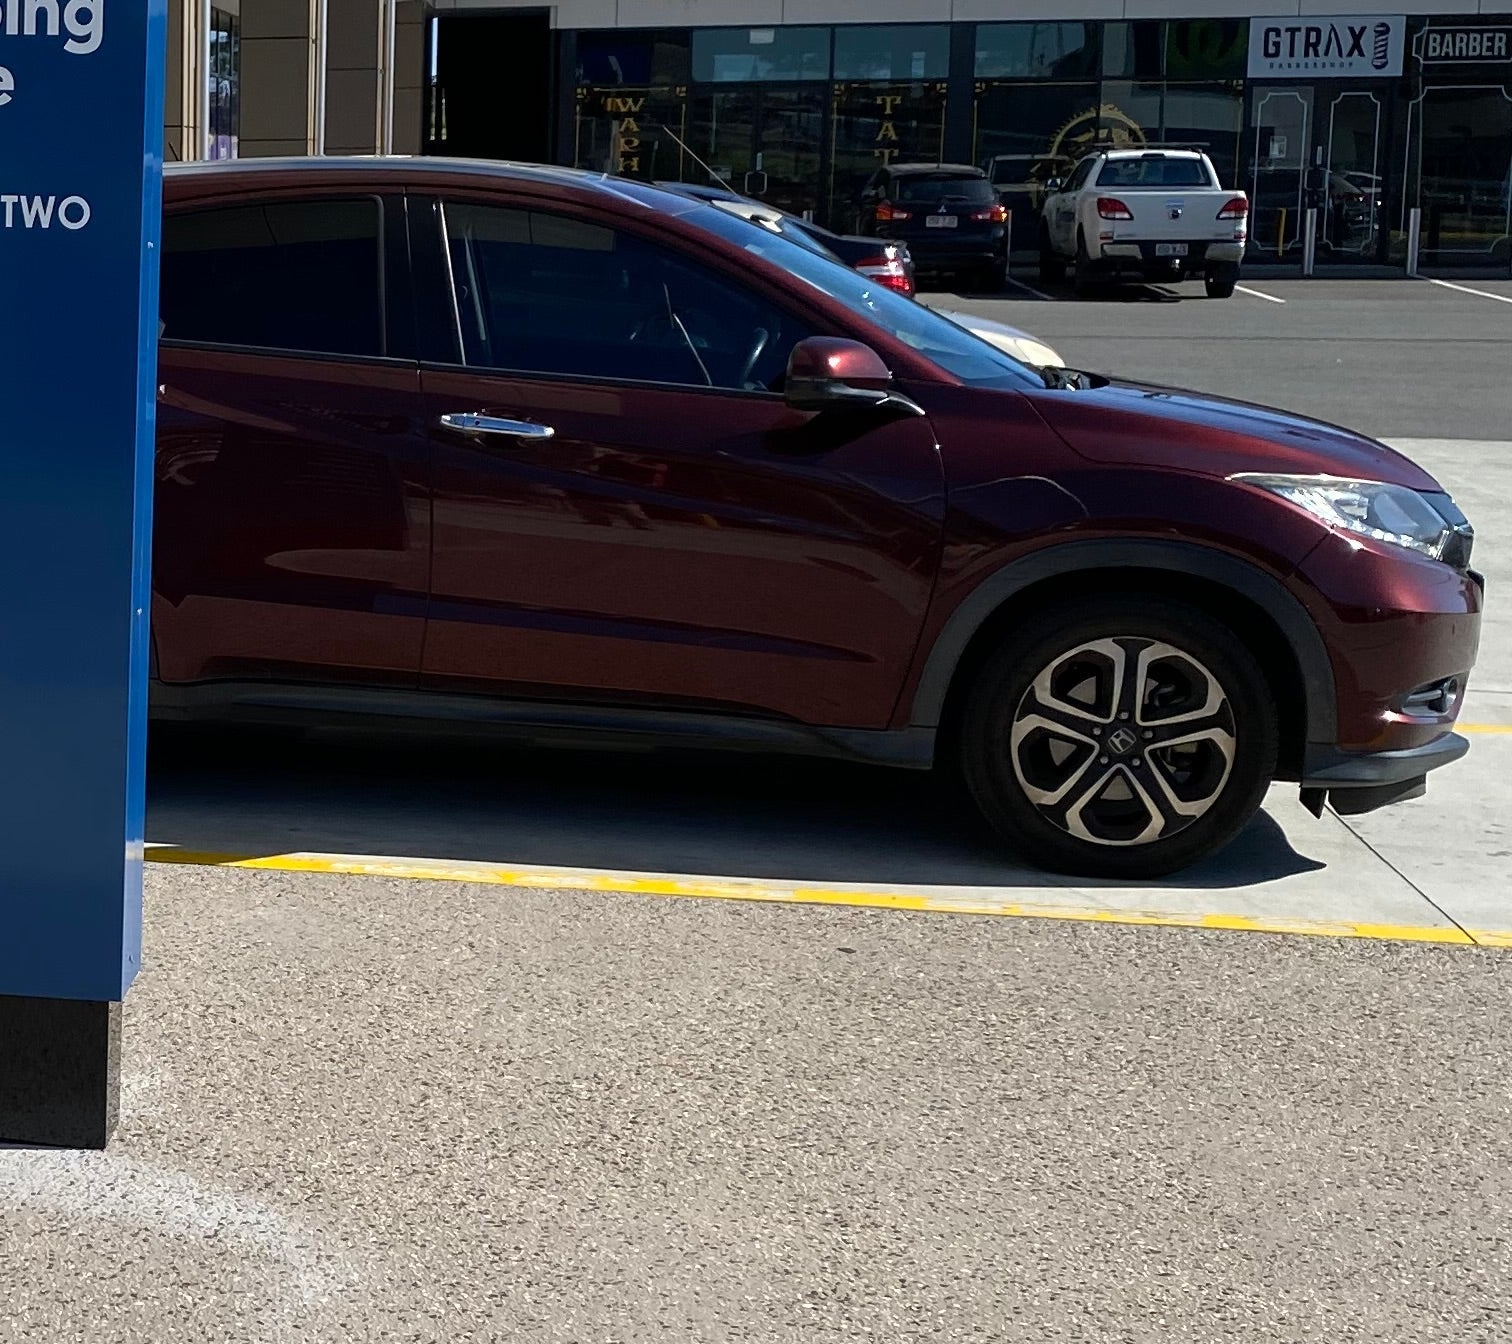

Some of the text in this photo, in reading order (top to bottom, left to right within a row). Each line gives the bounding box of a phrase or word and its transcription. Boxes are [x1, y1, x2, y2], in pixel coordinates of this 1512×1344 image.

[1263, 23, 1367, 58] GTRAX
[1427, 32, 1507, 57] BARBER
[0, 194, 92, 231] TWO
